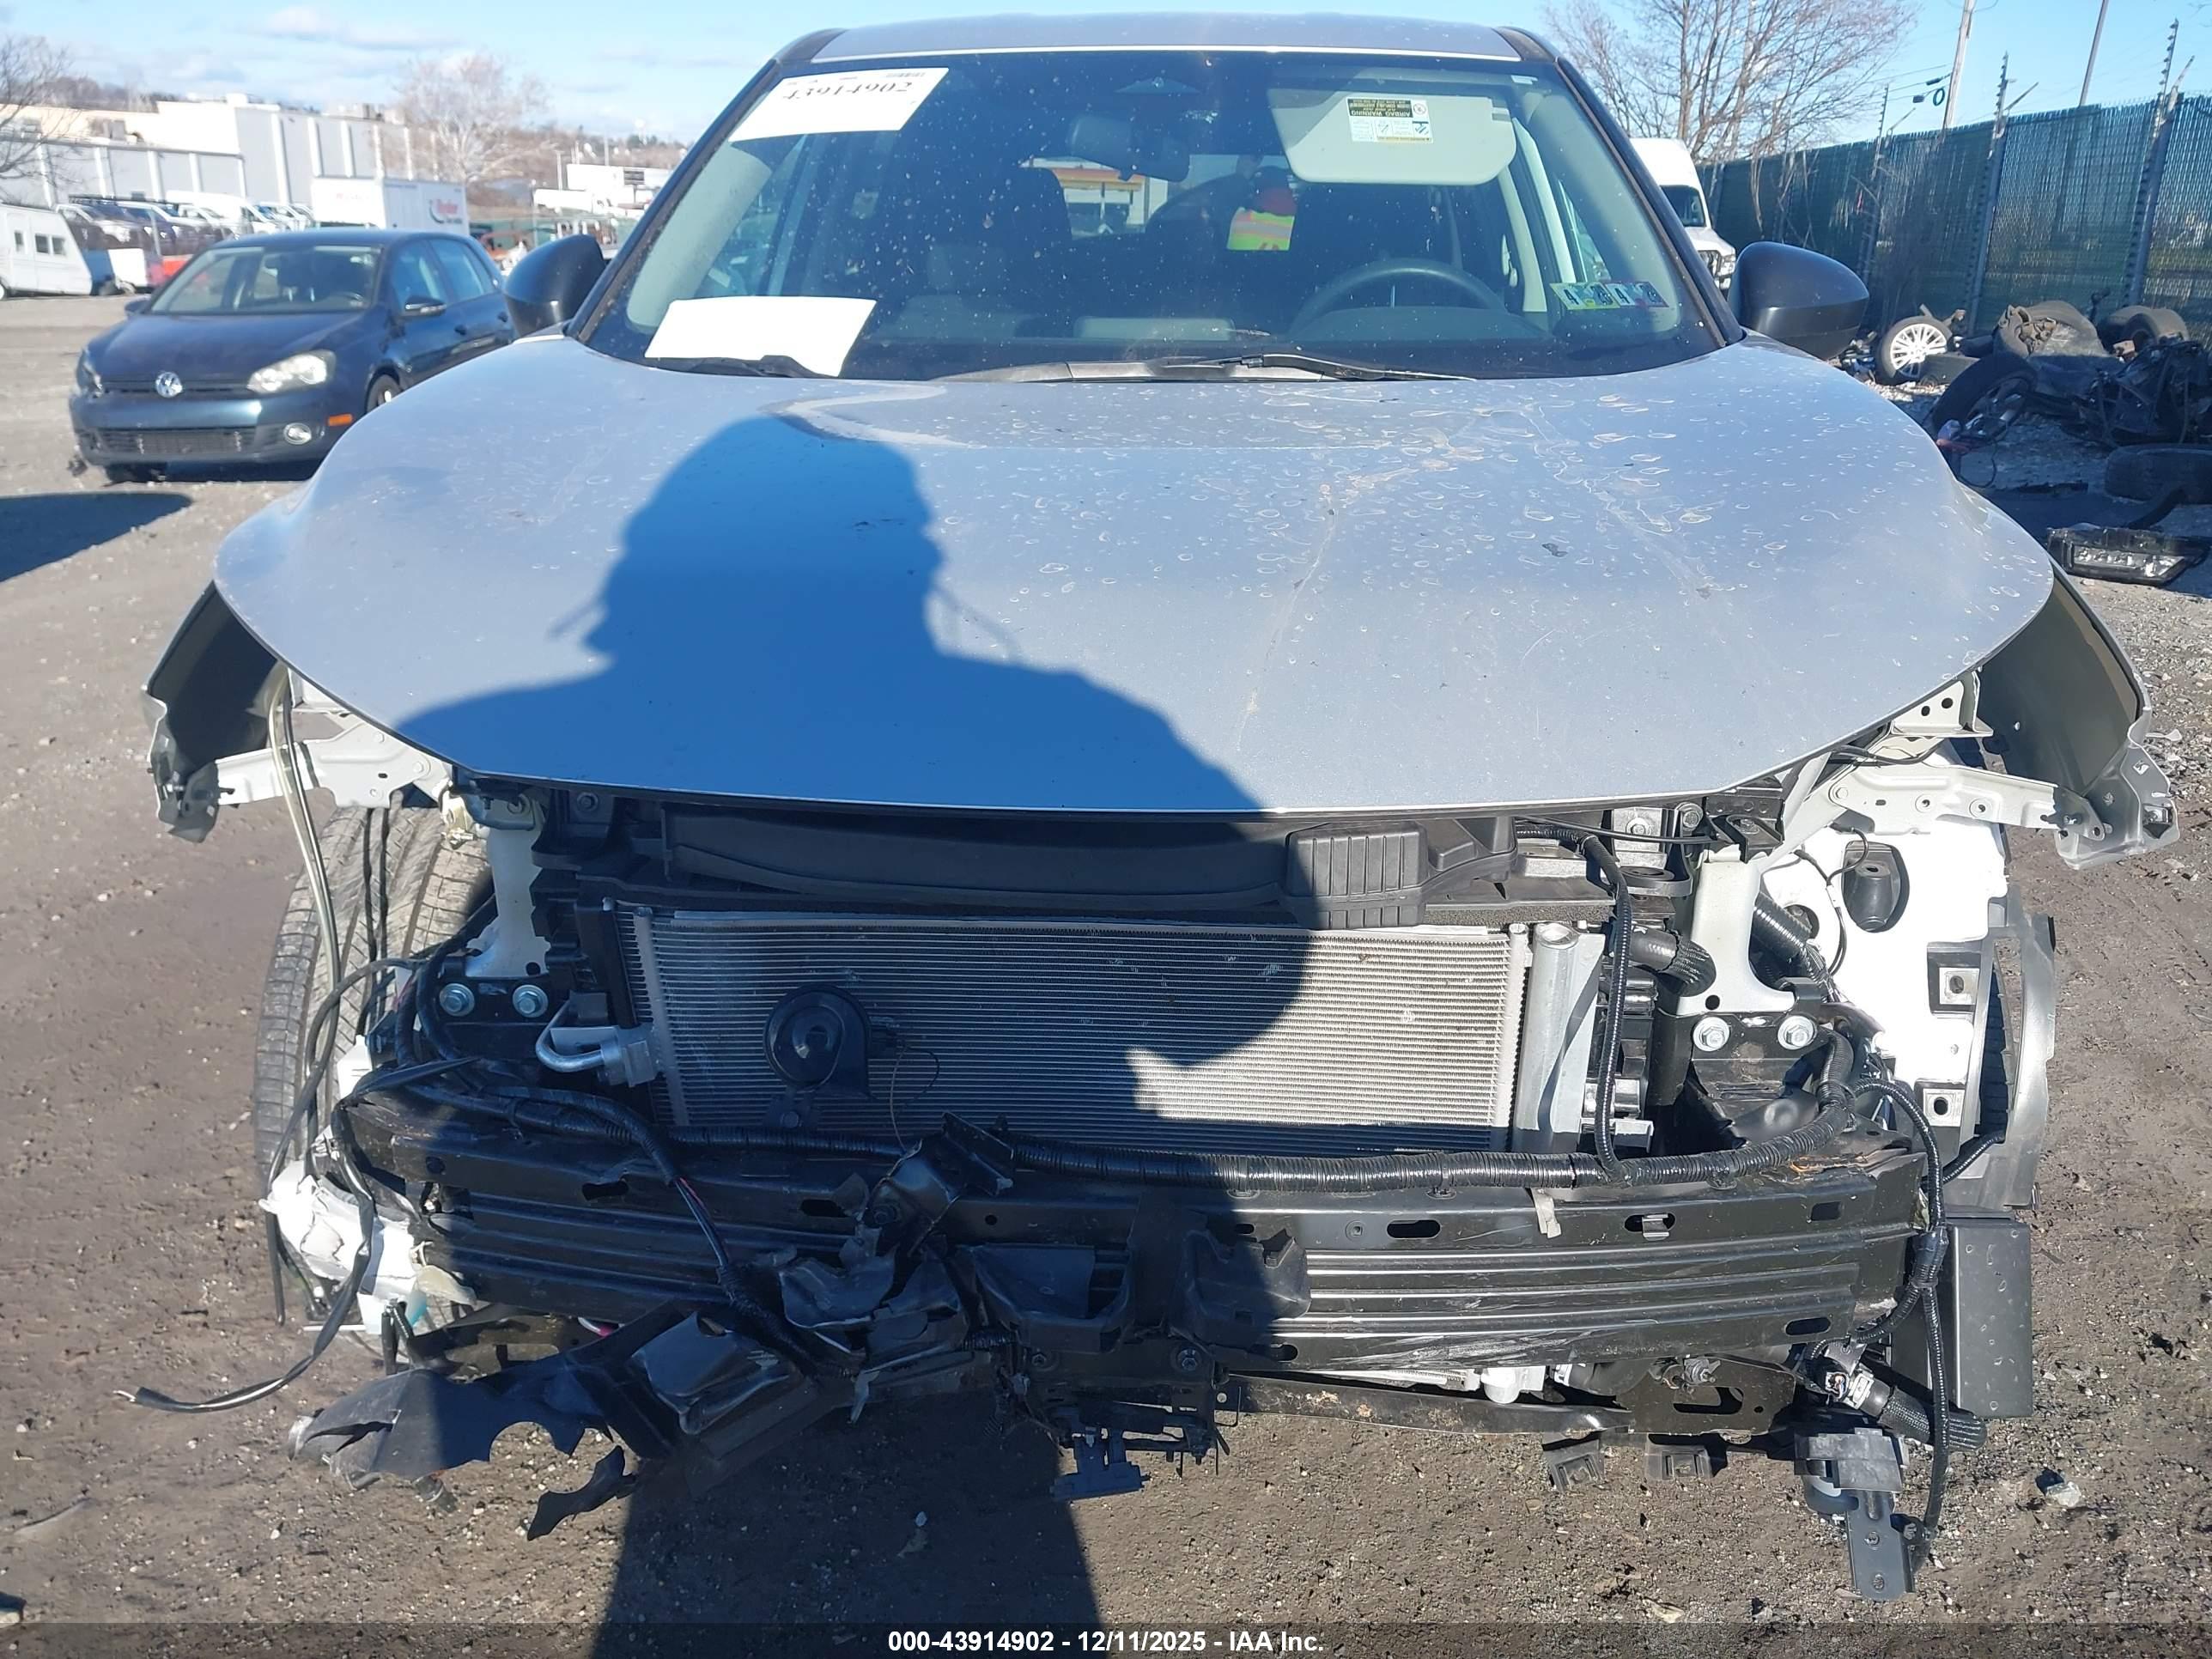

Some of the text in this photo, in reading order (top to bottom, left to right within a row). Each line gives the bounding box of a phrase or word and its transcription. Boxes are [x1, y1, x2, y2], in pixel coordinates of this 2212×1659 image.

[782, 82, 913, 100] 43914902
[1563, 289, 1579, 305] 4
[1614, 288, 1631, 304] 4
